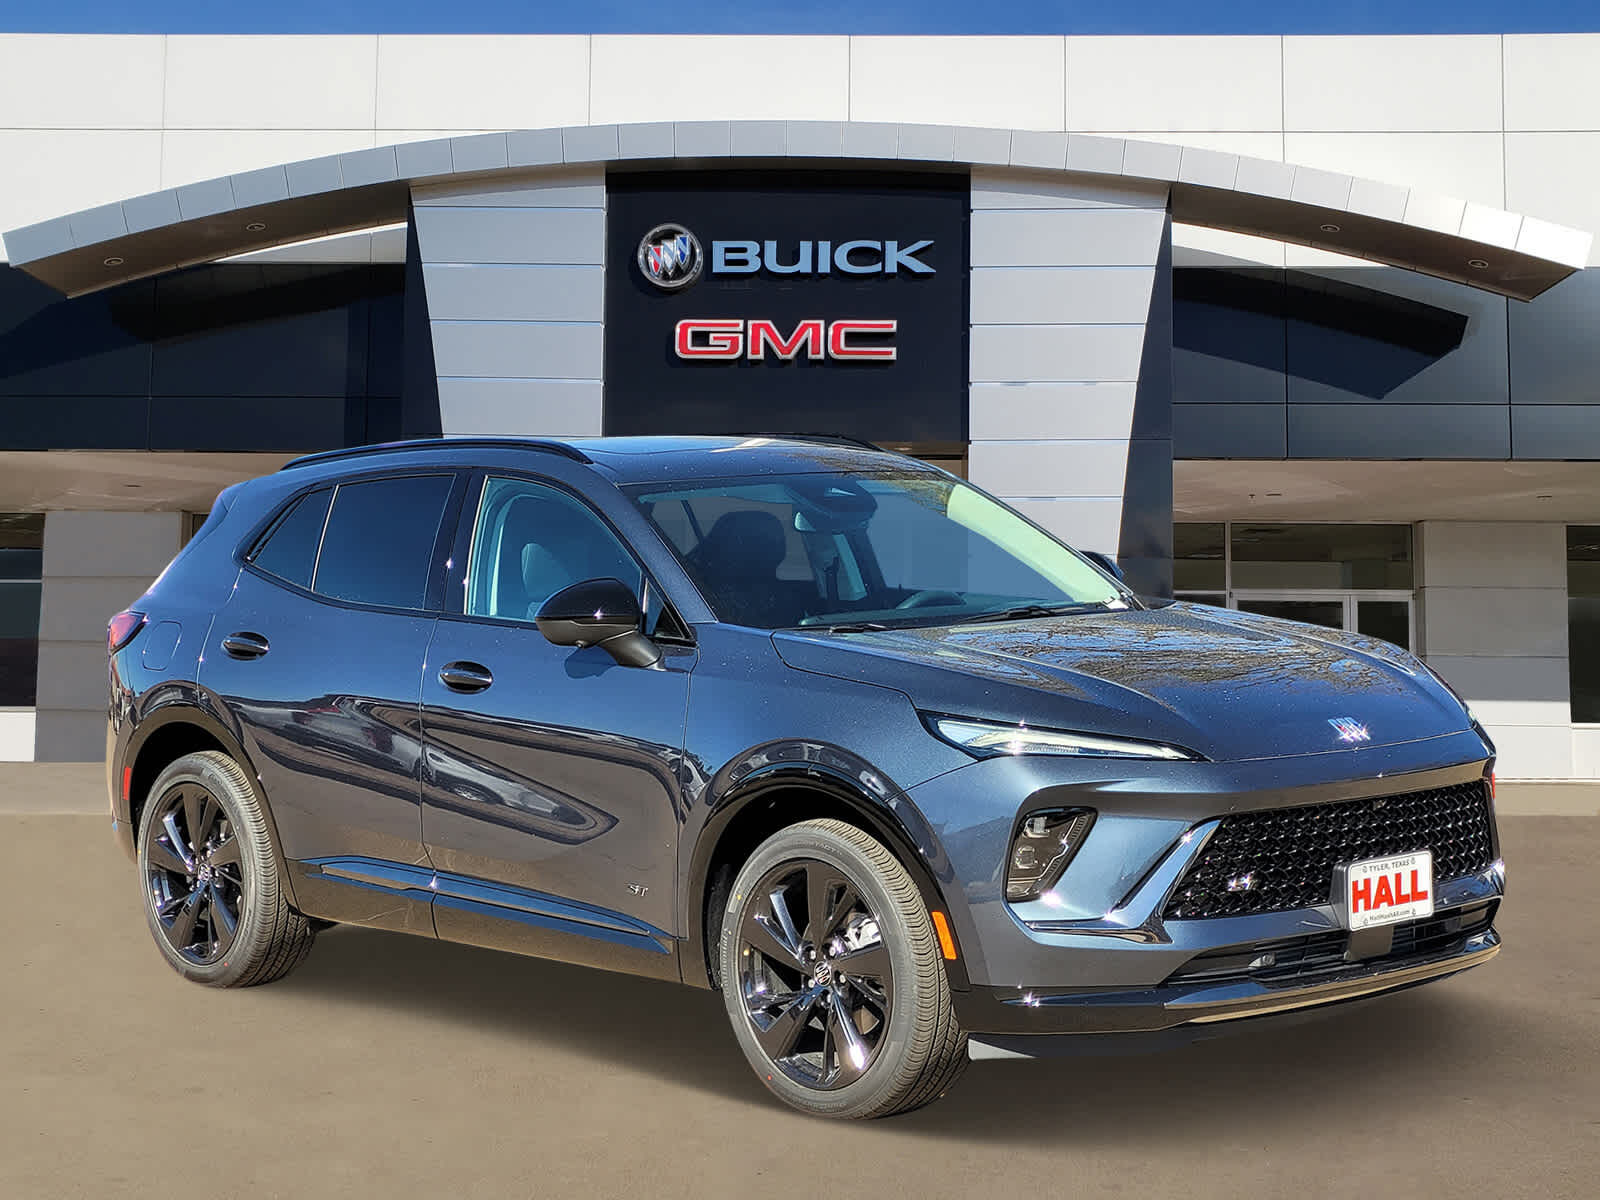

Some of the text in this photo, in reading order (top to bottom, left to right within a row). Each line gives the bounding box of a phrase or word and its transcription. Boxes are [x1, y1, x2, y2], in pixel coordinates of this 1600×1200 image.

[712, 240, 936, 273] BUICK
[675, 319, 897, 360] GMC
[1391, 859, 1410, 868] TEXAS
[1352, 869, 1428, 913] HALL
